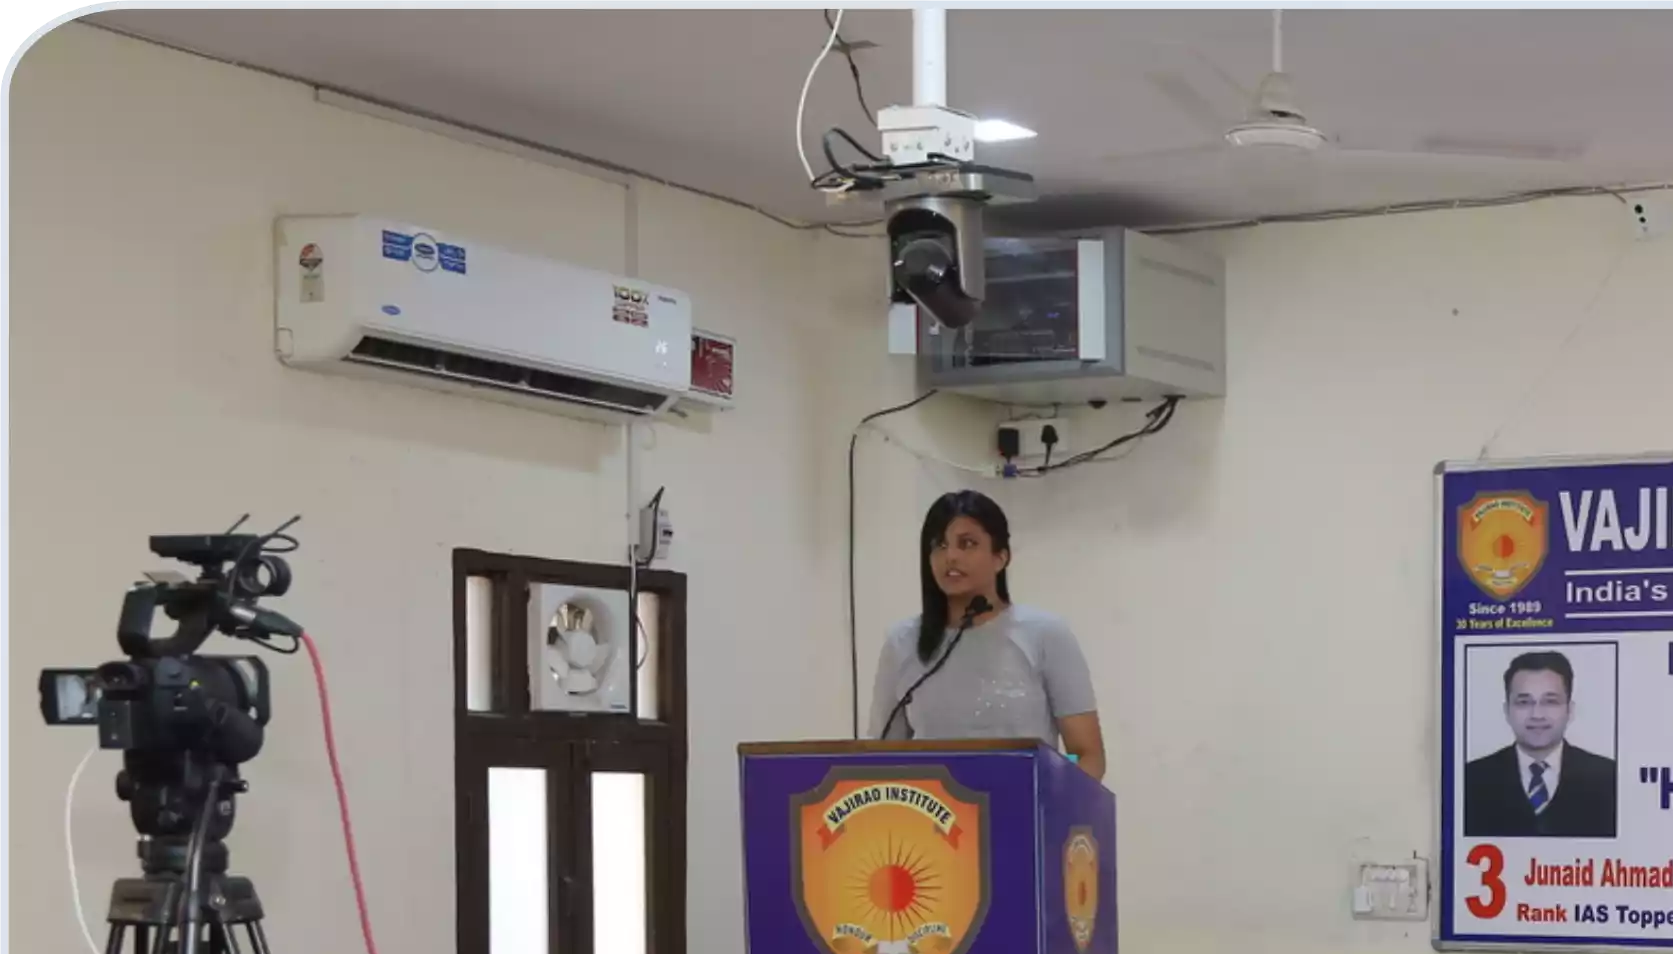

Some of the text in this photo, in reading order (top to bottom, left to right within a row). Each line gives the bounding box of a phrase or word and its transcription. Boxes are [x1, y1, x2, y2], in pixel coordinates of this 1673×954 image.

[1565, 579, 1668, 604] India's
[1469, 601, 1506, 615] Since
[827, 787, 951, 825] VAJIRAO INSTITUTE
[1465, 843, 1507, 920] 3
[1524, 858, 1594, 887] Junaid
[1517, 903, 1567, 923] Rank
[1575, 905, 1609, 924] IAS
